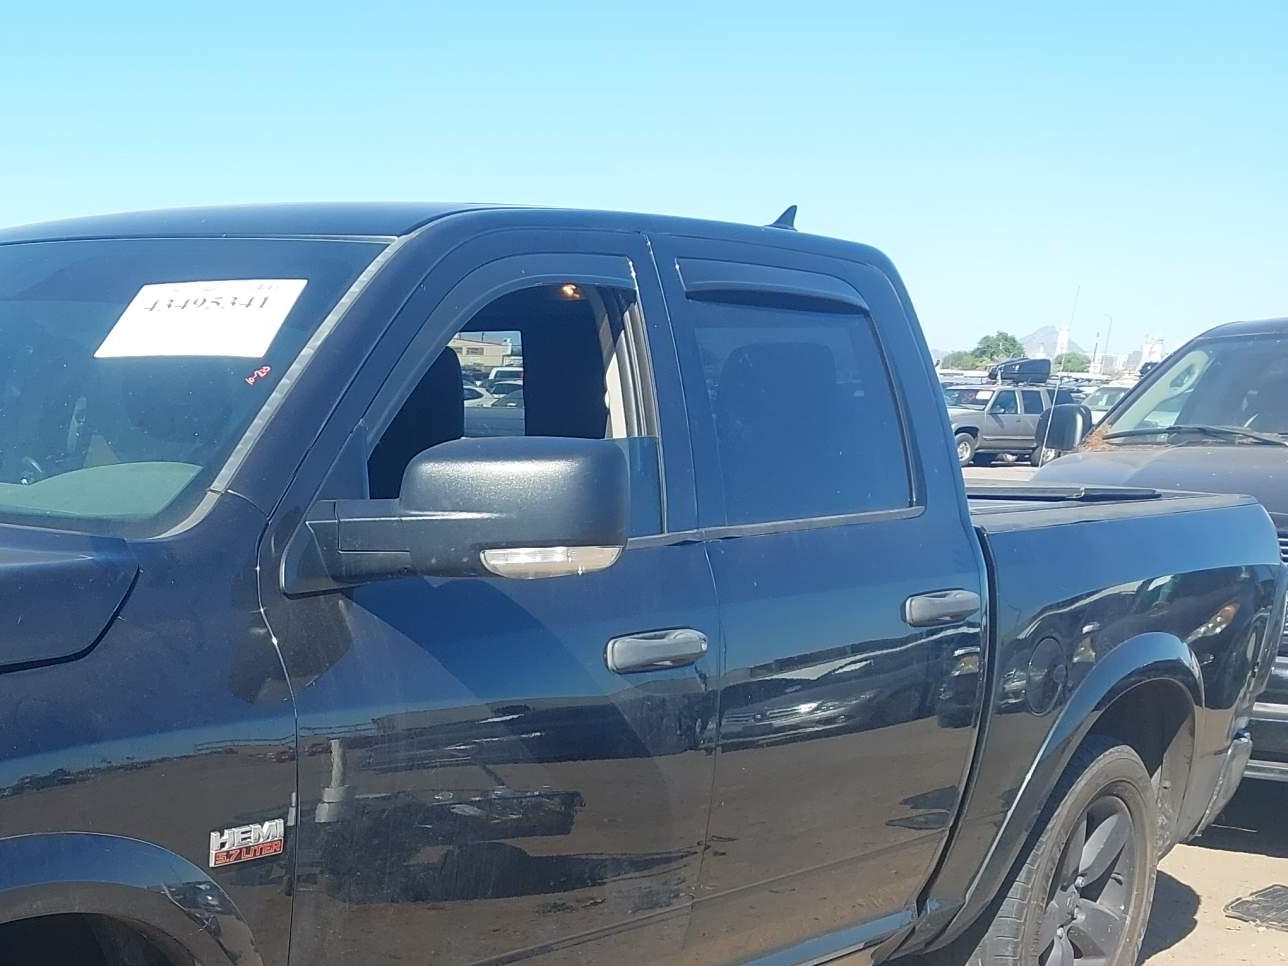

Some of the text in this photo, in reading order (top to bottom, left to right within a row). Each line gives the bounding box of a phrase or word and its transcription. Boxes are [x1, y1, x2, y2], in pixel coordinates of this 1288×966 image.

[209, 818, 284, 850] HEMI
[214, 840, 281, 864] 5.7 LITER
